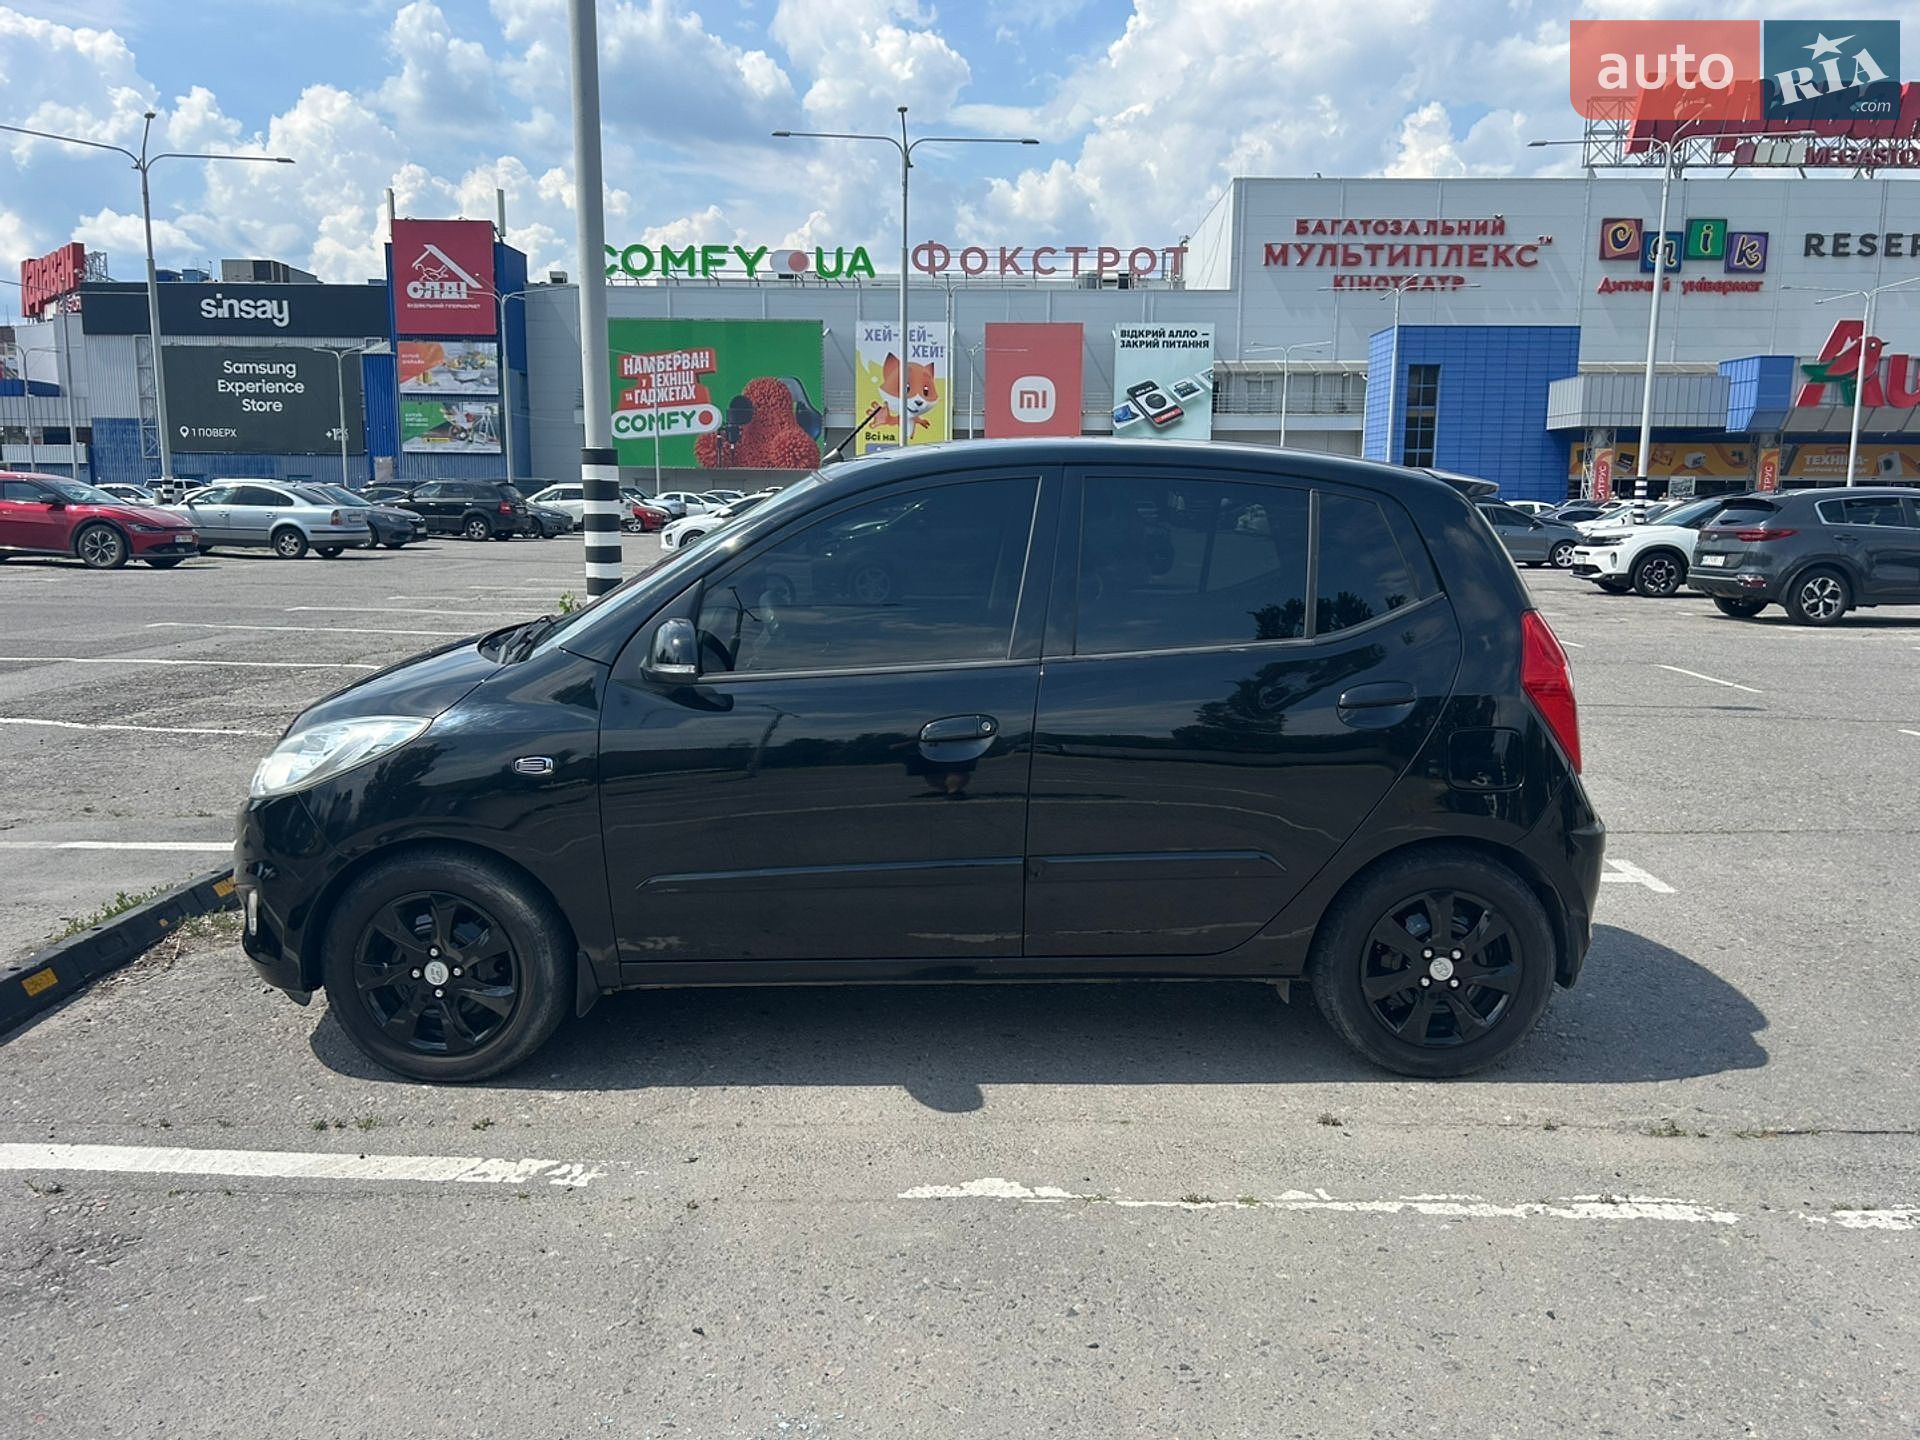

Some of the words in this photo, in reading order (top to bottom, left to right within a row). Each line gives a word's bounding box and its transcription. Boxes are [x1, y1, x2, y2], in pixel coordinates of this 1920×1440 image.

[1295, 214, 1506, 236] БАГАТОЗАЛЬНИЙ
[911, 240, 1189, 277] ФОКСТРОТ
[1333, 274, 1465, 292] КІНОТЕАТР
[200, 293, 290, 328] sinsay
[1120, 328, 1166, 339] ВІДКРИЙ
[1168, 330, 1198, 338] АЛЛО
[911, 341, 945, 358] ХЕЙ!
[1120, 338, 1160, 349] ЗАКРИЙ
[1162, 340, 1210, 349] ПИТАННЯ
[223, 360, 297, 379] Samsung
[623, 351, 710, 376] НАМБЕРВАН
[650, 370, 694, 387] ТЕХНІЦІ
[217, 379, 305, 396] Experience
[634, 384, 696, 405] ГАДЖЕТАХ
[242, 399, 283, 412] Store
[614, 410, 696, 433] COMFY
[198, 428, 237, 438] ПОВЕРХ
[865, 431, 880, 441] Всі
